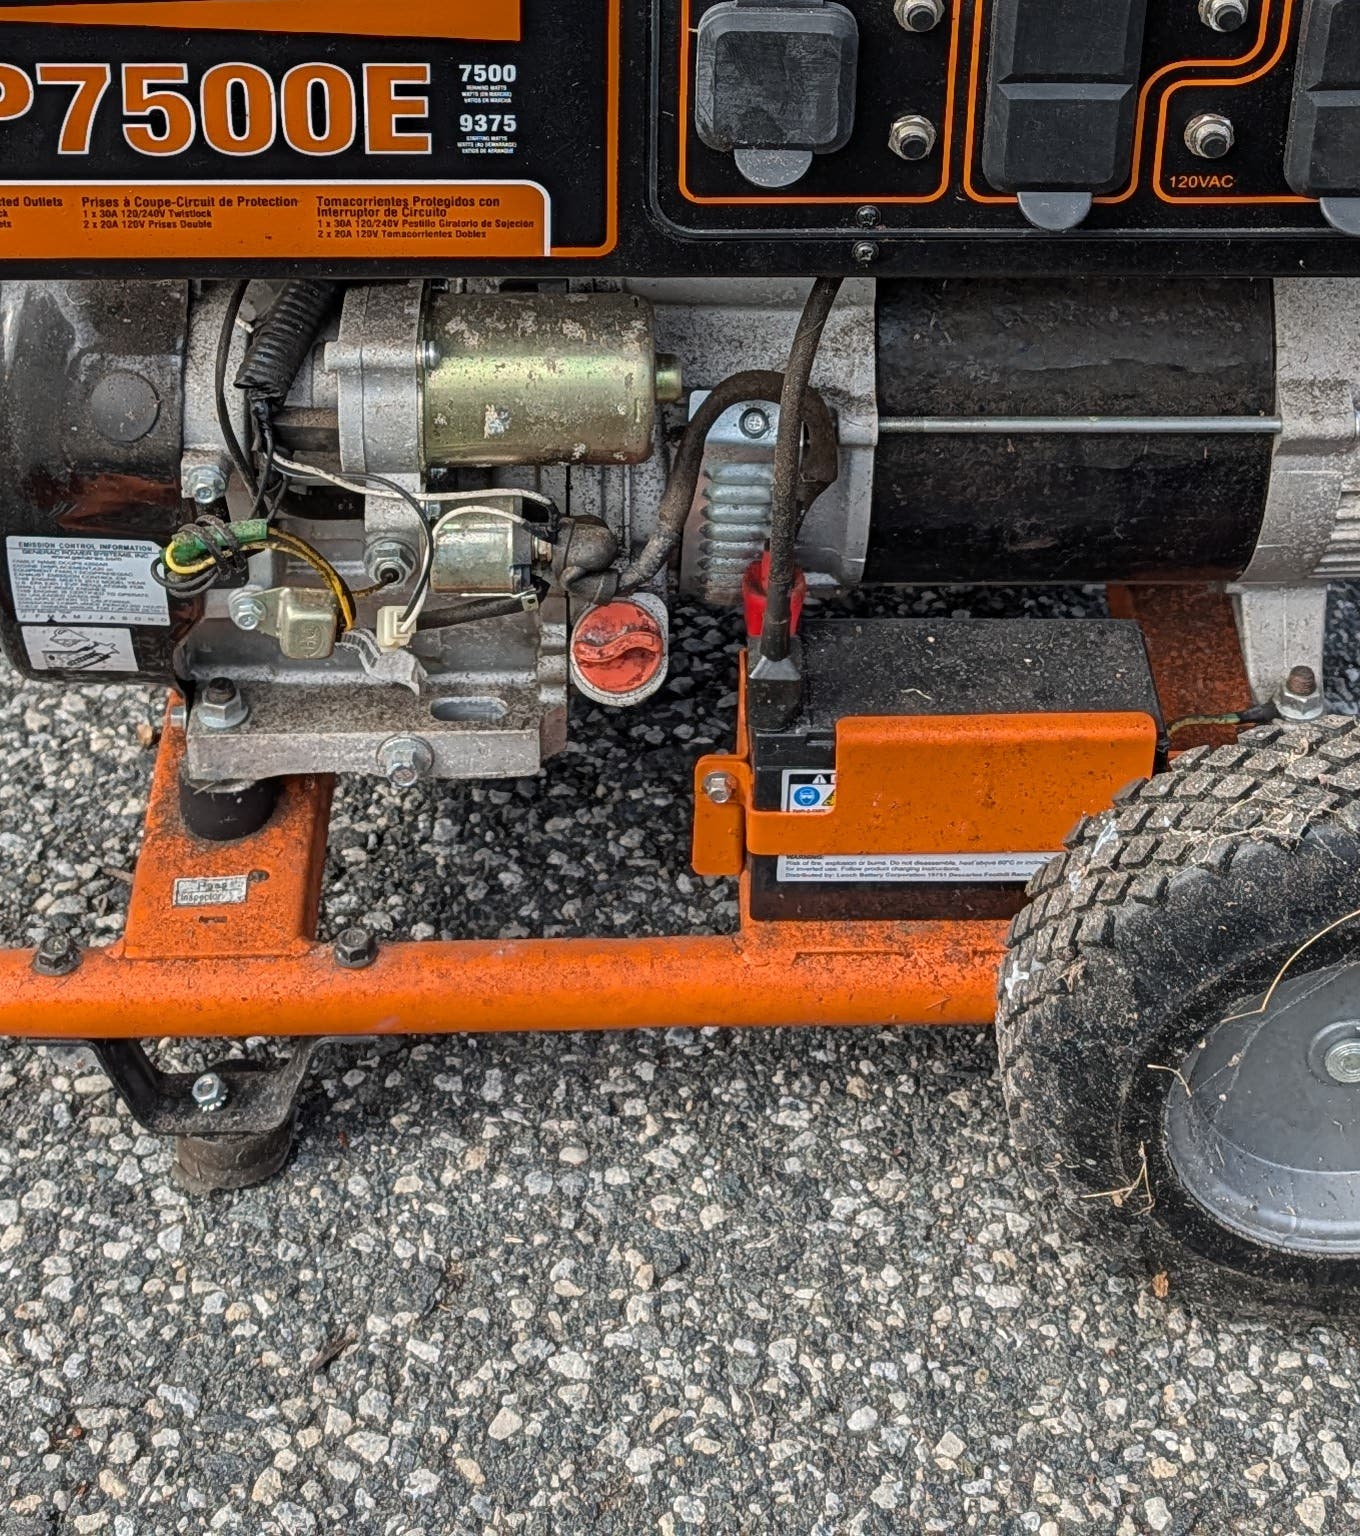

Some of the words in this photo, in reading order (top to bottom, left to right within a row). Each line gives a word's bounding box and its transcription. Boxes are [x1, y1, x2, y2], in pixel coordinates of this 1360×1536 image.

[458, 64, 517, 83] 7500
[459, 114, 517, 132] 9375
[1168, 173, 1235, 189] 120VAC
[23, 197, 63, 208] Outlets
[82, 196, 119, 207] Prises
[134, 196, 215, 208] Coupe-Circuit
[219, 196, 233, 206] de
[237, 196, 298, 207] Protection
[316, 196, 409, 207] Tomacorrientes
[412, 196, 475, 209] Protegidos
[479, 198, 500, 206] con
[100, 210, 118, 218] 30A
[122, 210, 166, 218] 120/240V
[168, 210, 212, 218] Twistlock
[317, 207, 380, 219] Interruptor
[384, 207, 398, 217] de
[402, 207, 447, 218] Circuito
[83, 220, 90, 228] 2
[100, 220, 118, 228] 20A
[122, 220, 145, 228] 120V
[148, 220, 178, 228] Prises
[180, 220, 212, 228] Double
[334, 220, 352, 228] 30A
[356, 220, 398, 228] 120/240V
[402, 220, 436, 228] Pestillo
[482, 220, 492, 228] de
[318, 230, 324, 238] 2
[334, 230, 352, 238] 20A
[356, 230, 378, 238] 120V
